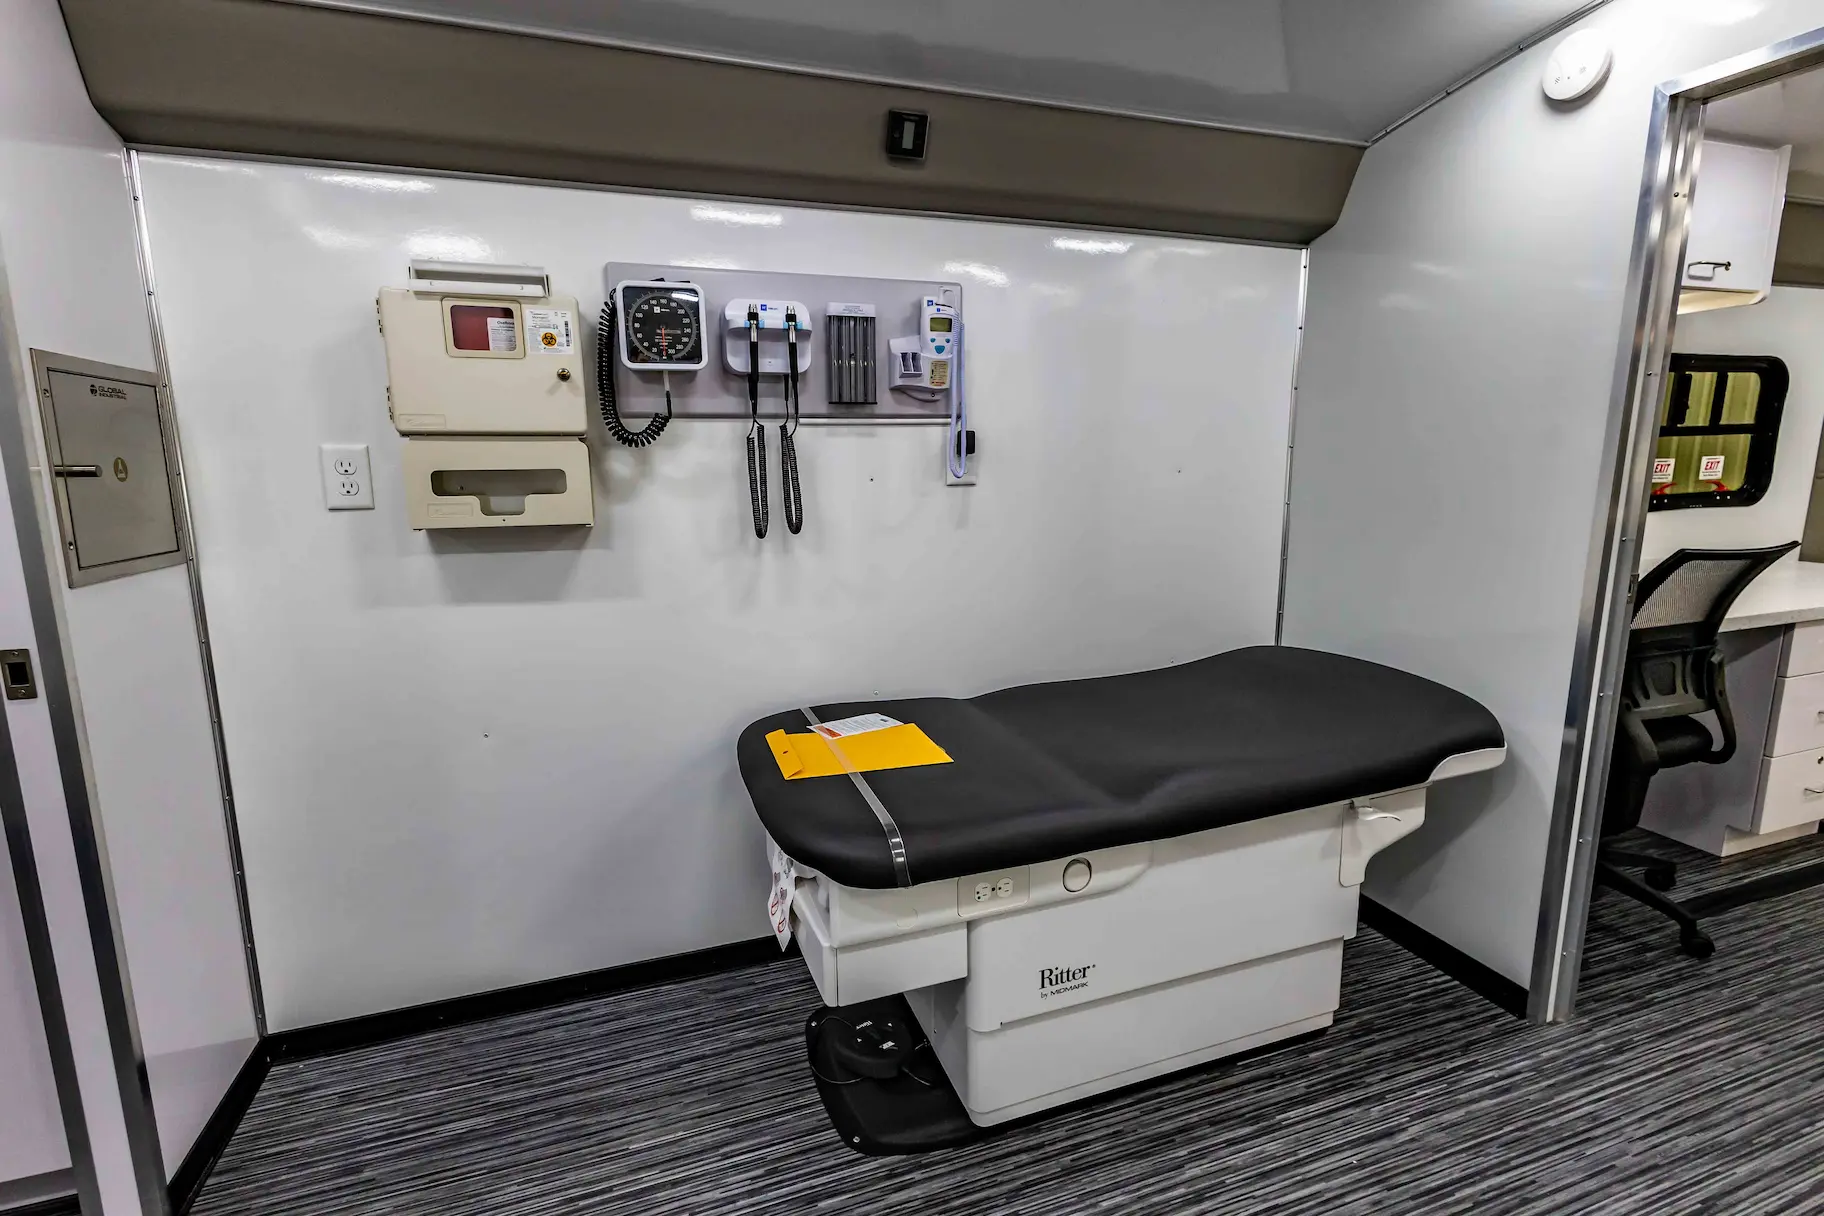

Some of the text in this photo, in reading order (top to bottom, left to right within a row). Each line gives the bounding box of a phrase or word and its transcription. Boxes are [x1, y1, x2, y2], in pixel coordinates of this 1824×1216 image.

[98, 386, 126, 396] GLOBAL
[1654, 463, 1671, 474] EXIT
[1704, 460, 1720, 470] EXIT
[1038, 966, 1090, 990] Ritter
[1040, 981, 1088, 1000] by MIDMARK
